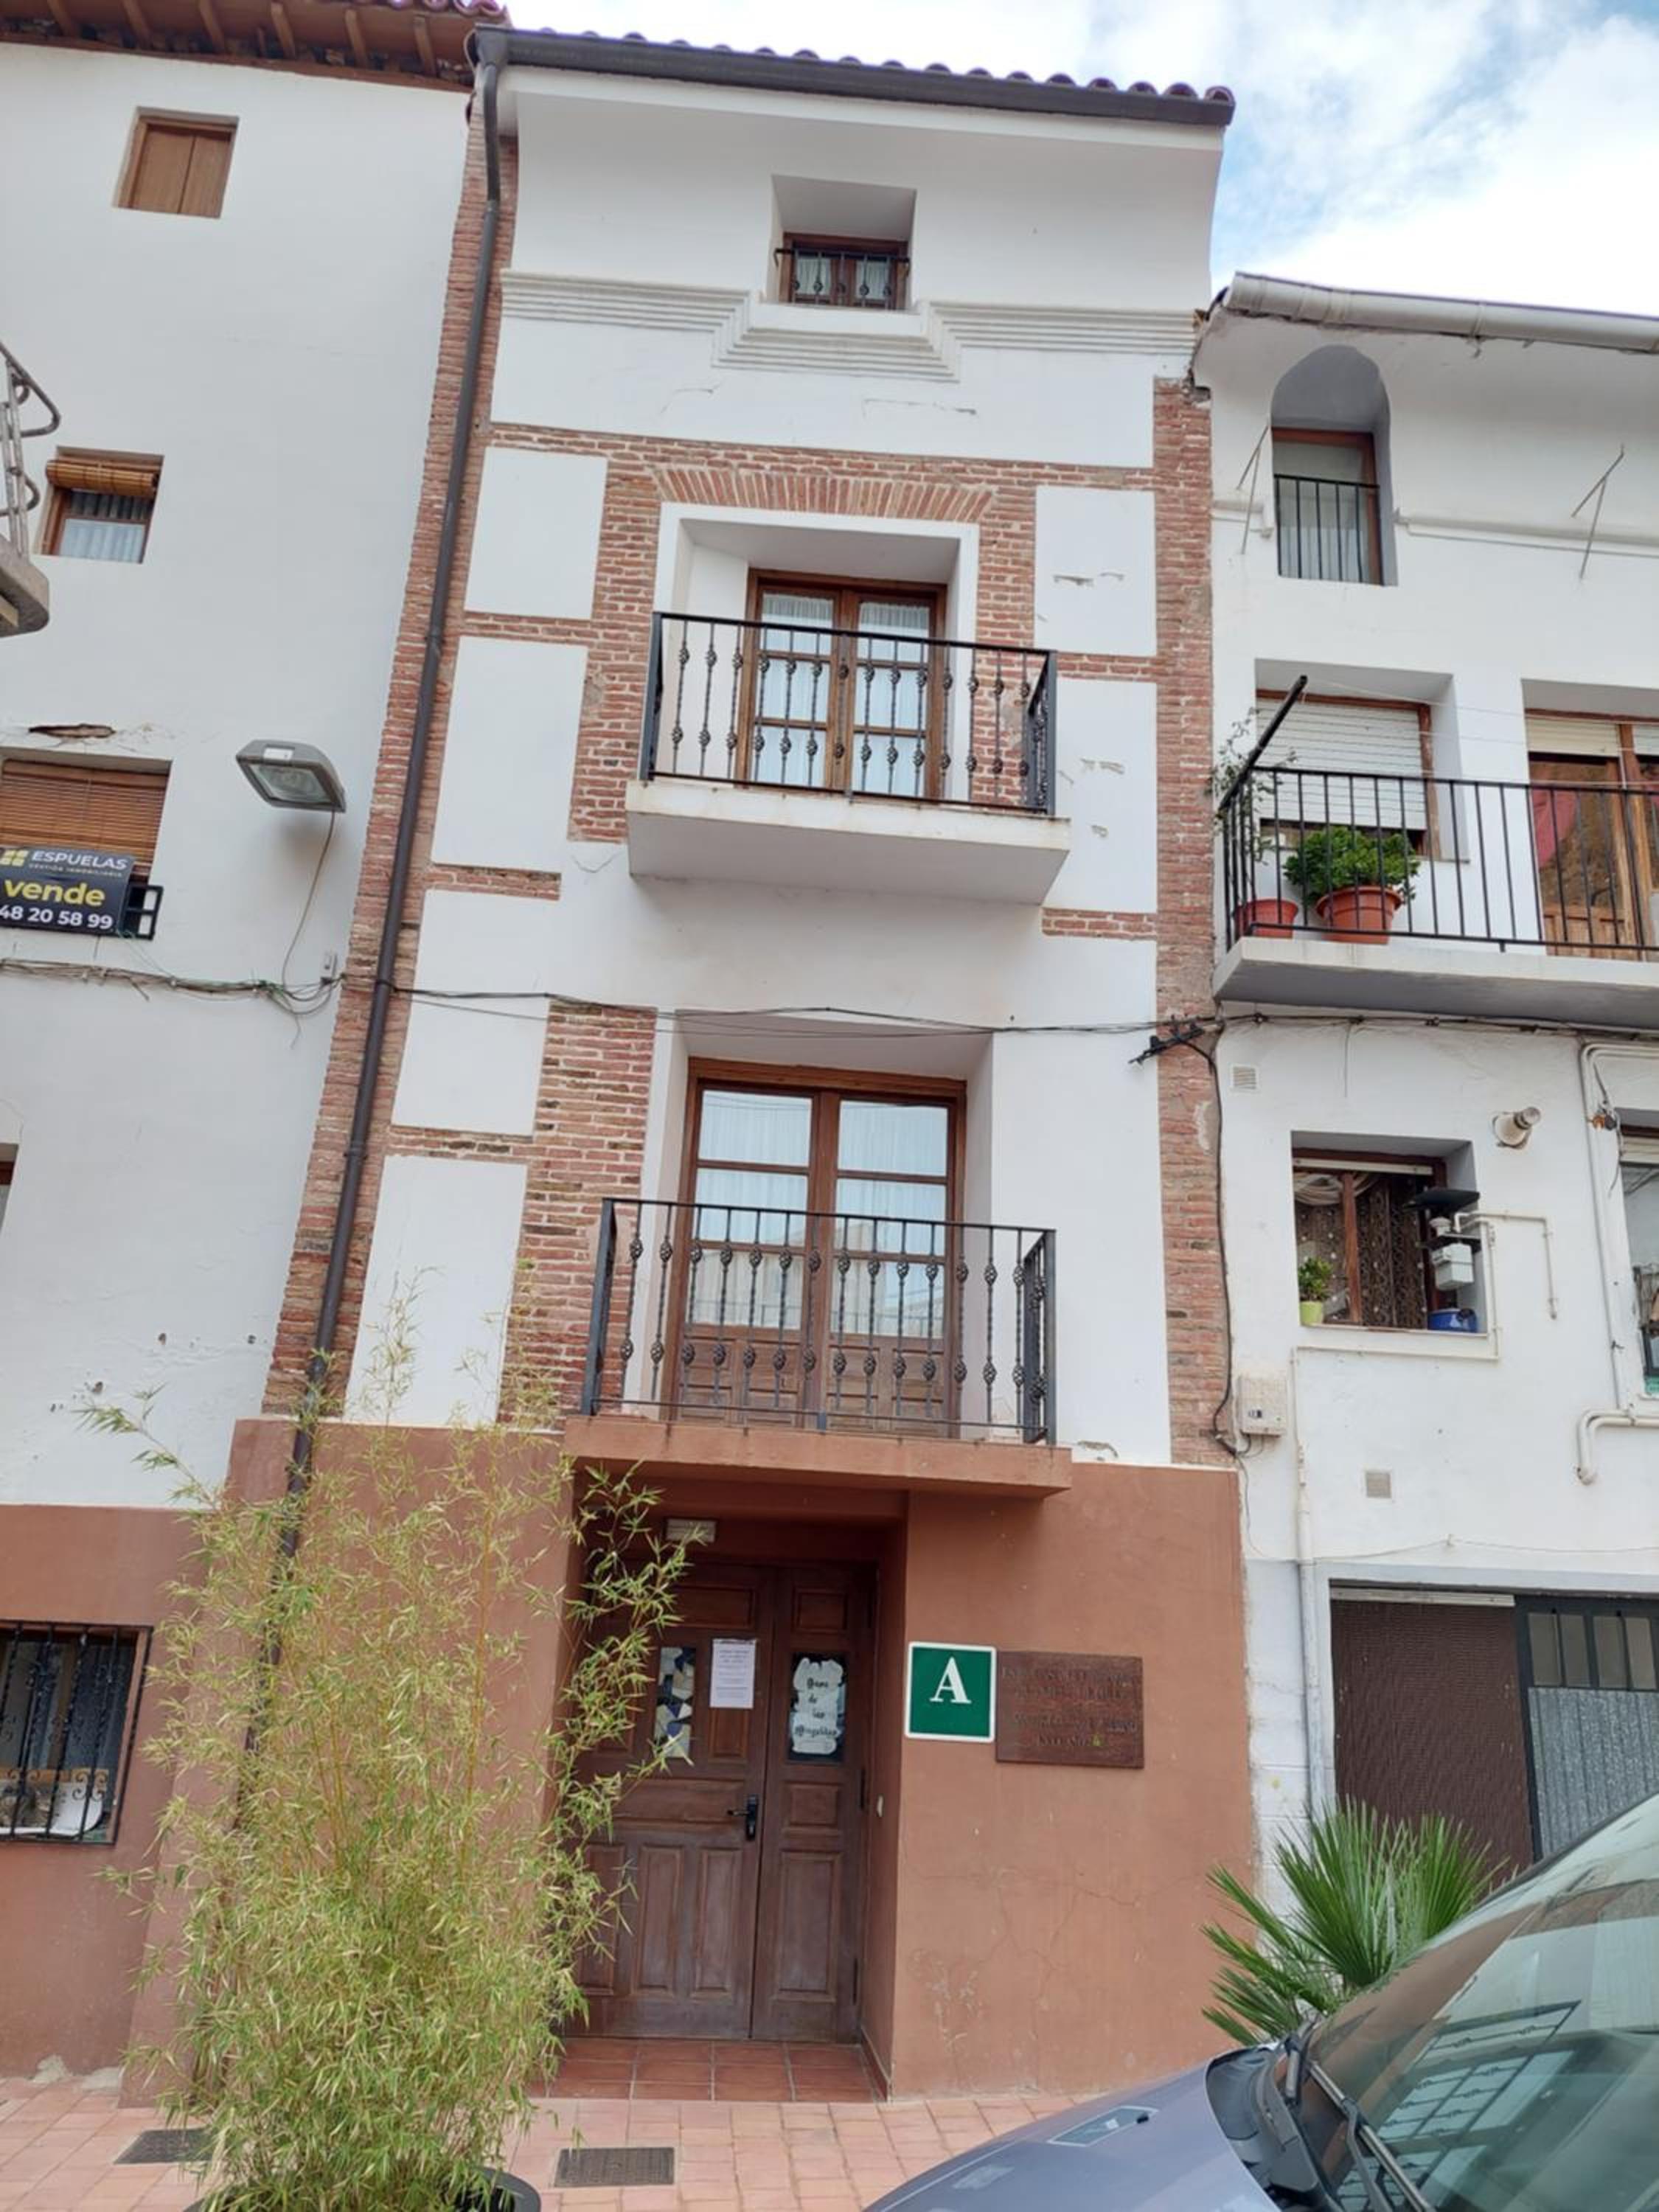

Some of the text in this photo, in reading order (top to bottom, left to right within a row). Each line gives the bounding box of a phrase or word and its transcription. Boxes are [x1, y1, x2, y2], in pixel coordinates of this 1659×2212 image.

[32, 850, 128, 871] ESPUELAS
[4, 879, 105, 907] vende
[27, 906, 54, 923] 20
[58, 910, 83, 927] 58
[87, 914, 114, 931] 99
[929, 1657, 972, 1704] A
